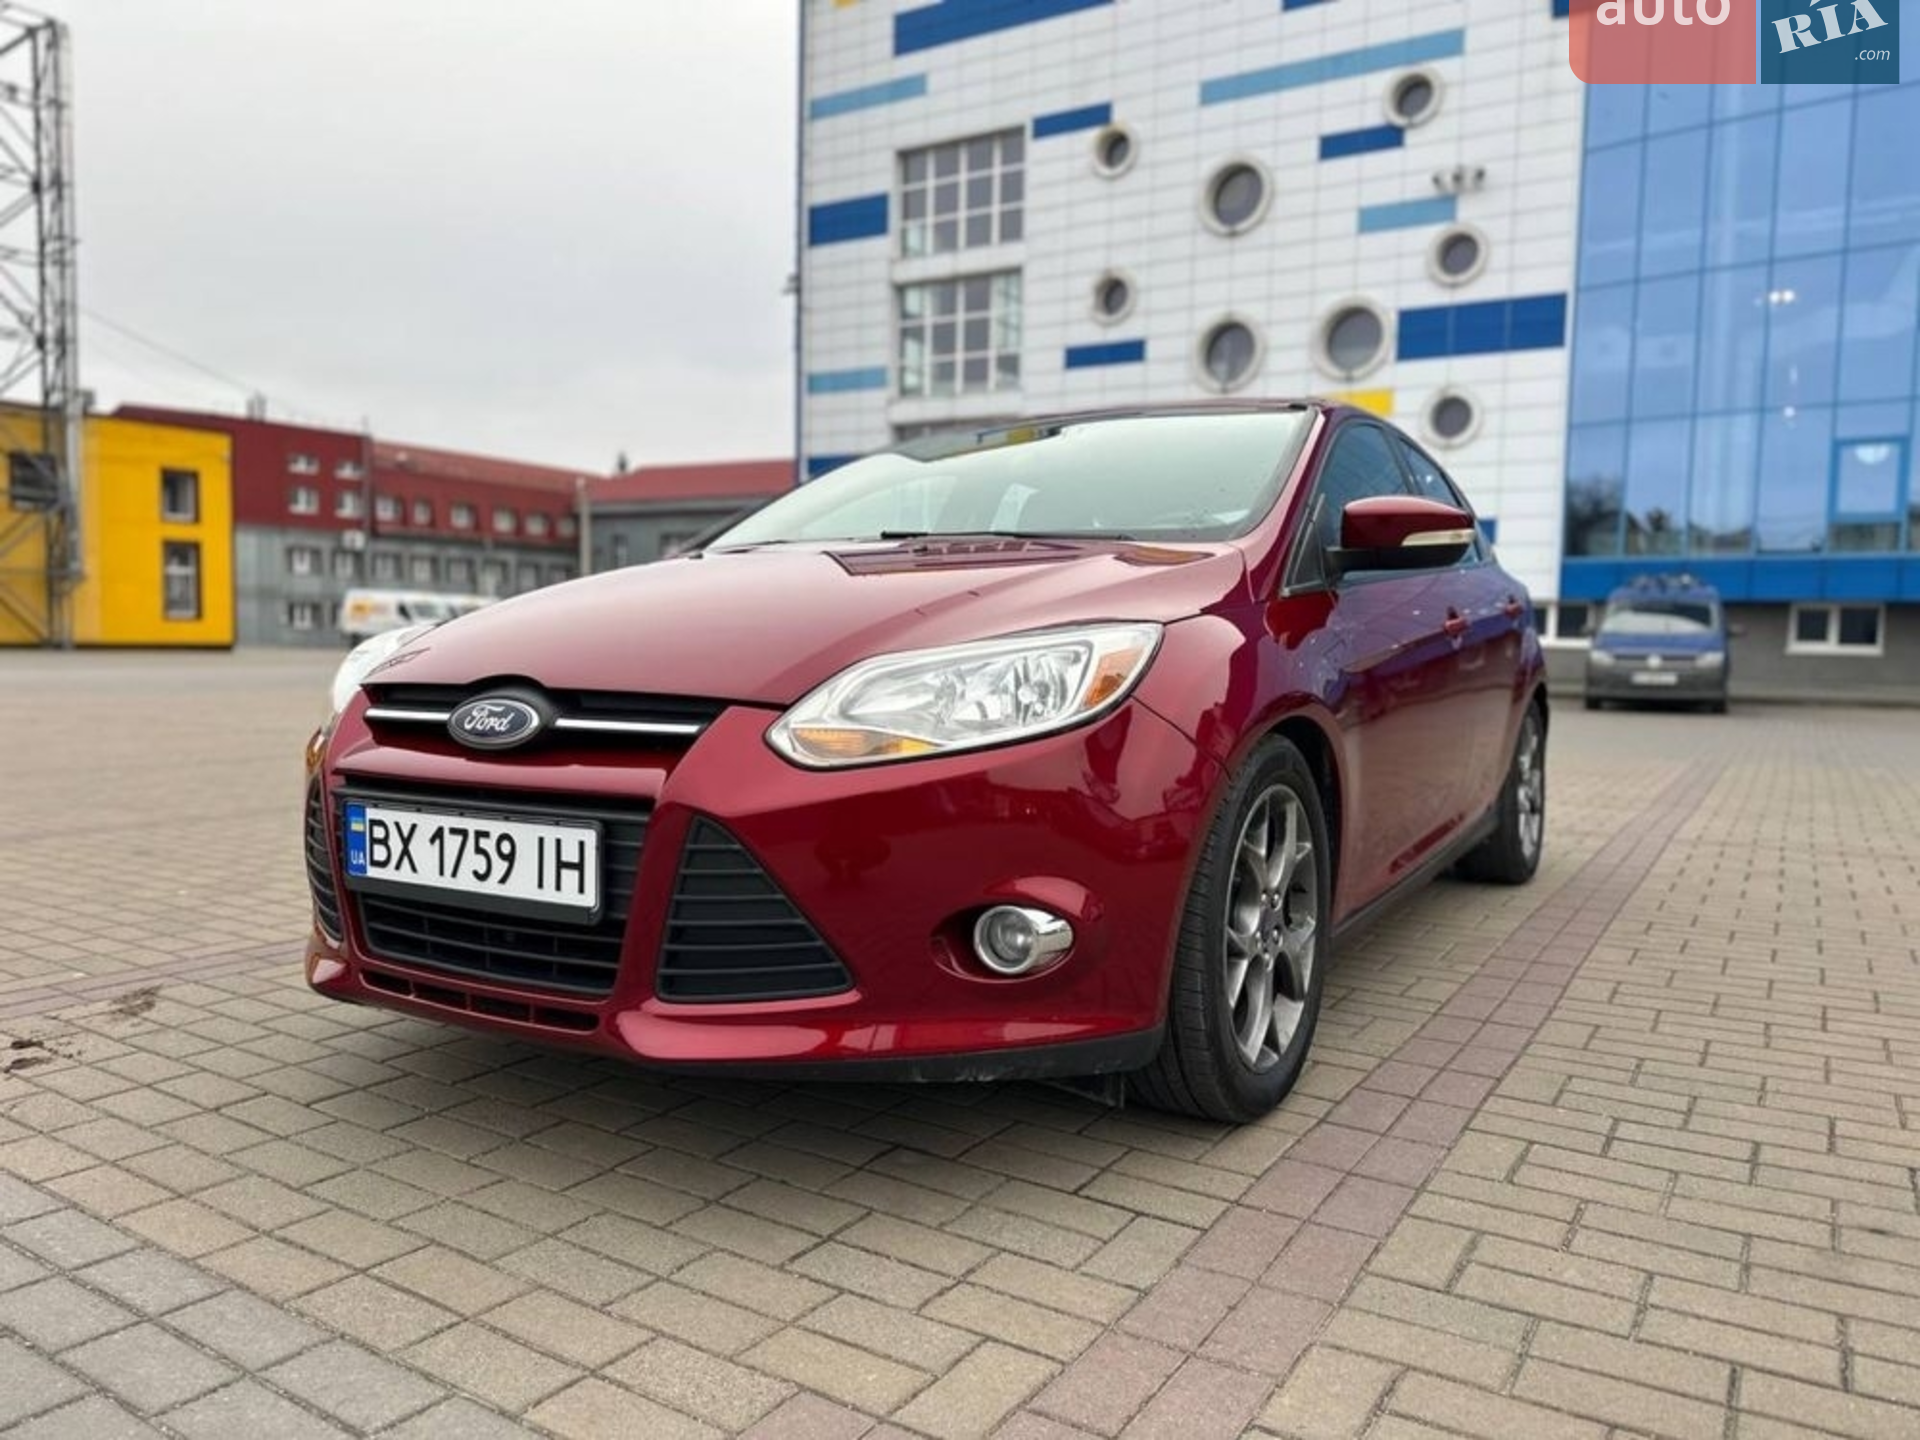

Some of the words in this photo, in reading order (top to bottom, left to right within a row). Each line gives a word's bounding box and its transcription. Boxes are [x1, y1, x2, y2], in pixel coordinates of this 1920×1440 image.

[463, 703, 515, 732] Ford
[350, 849, 366, 866] UA
[369, 818, 418, 874] BX
[428, 825, 517, 885] 1759
[537, 836, 585, 894] IH
